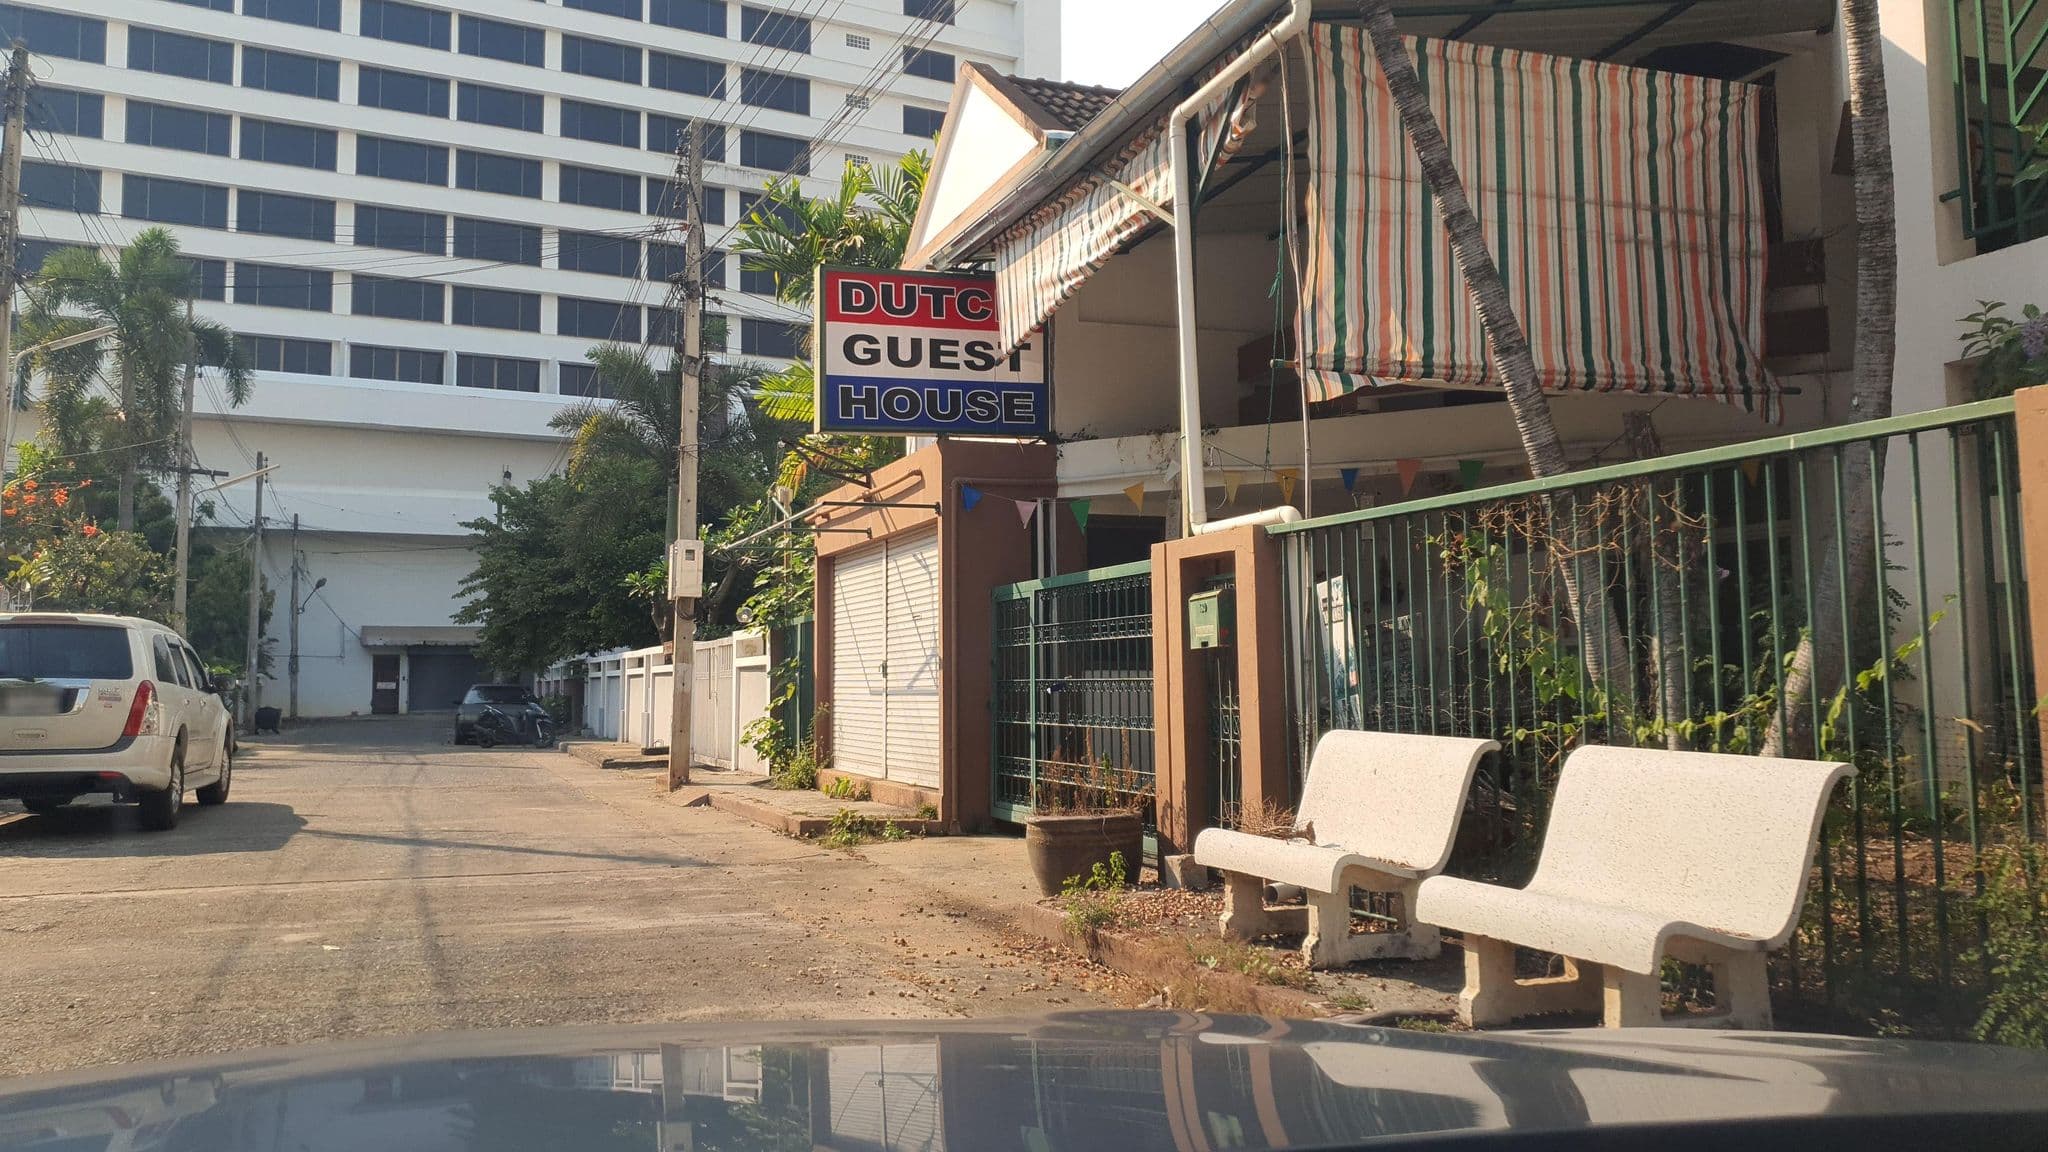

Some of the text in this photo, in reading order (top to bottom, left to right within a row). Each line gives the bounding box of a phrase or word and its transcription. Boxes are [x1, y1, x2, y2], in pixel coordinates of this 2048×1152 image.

[838, 279, 1000, 322] DUTC
[843, 334, 1031, 372] GUEST
[839, 385, 1035, 424] HOUSE
